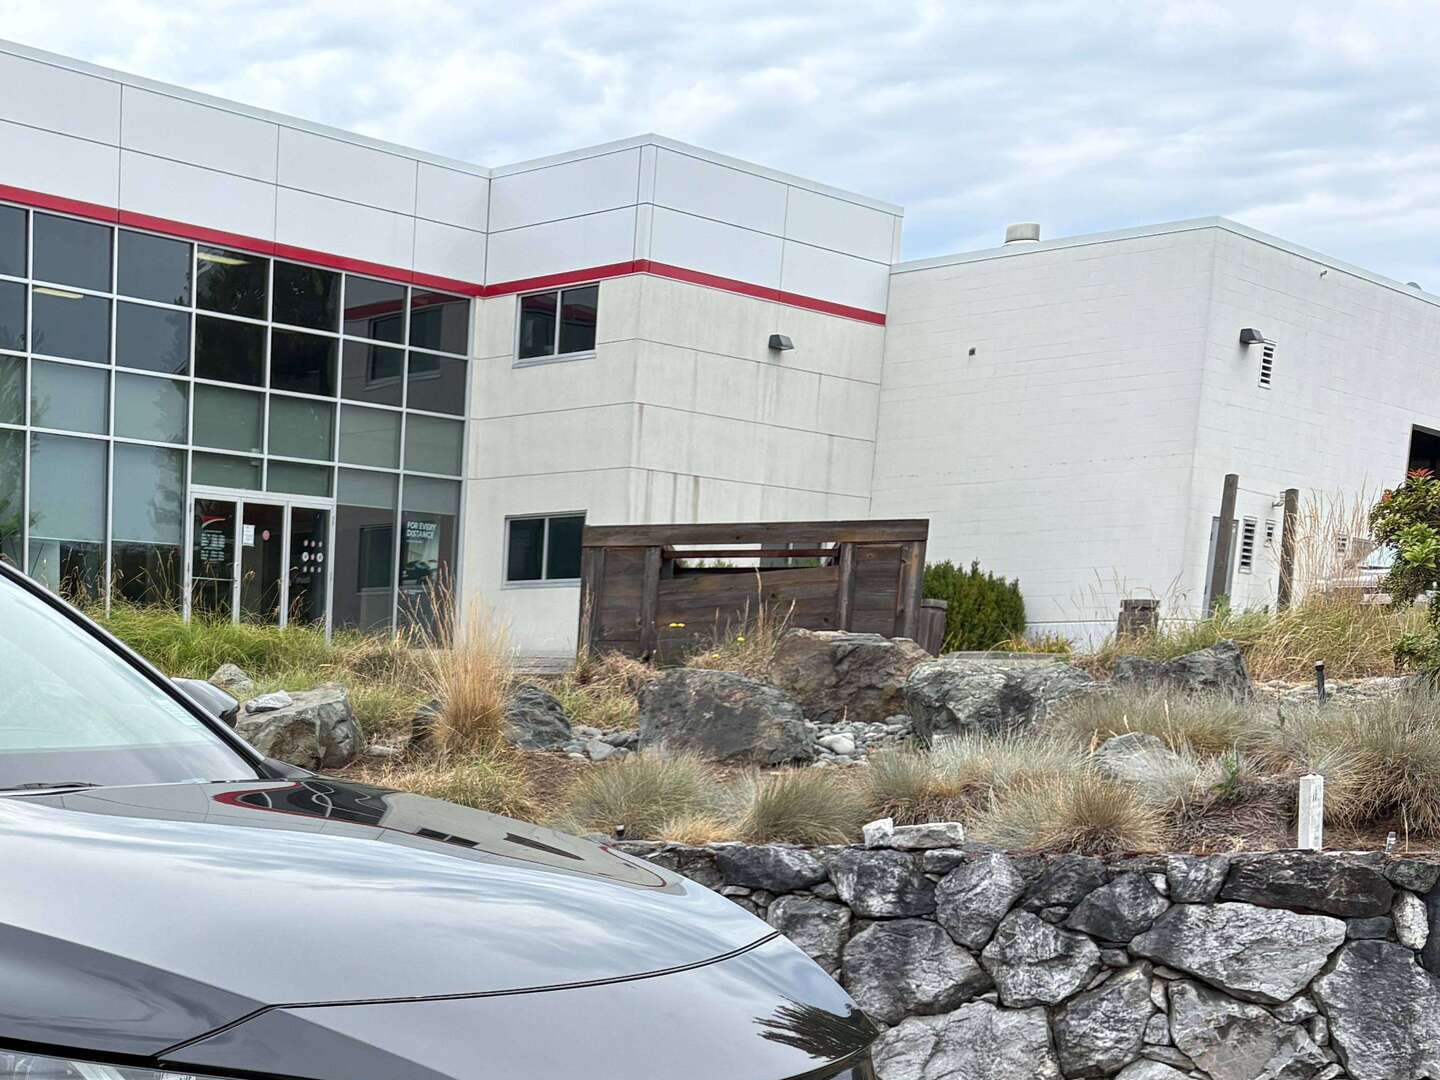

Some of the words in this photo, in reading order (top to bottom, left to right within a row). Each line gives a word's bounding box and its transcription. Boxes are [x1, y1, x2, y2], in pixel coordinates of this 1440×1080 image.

[407, 521, 418, 529] FOR
[419, 522, 437, 531] EVERY
[406, 529, 434, 539] DISTANCE
